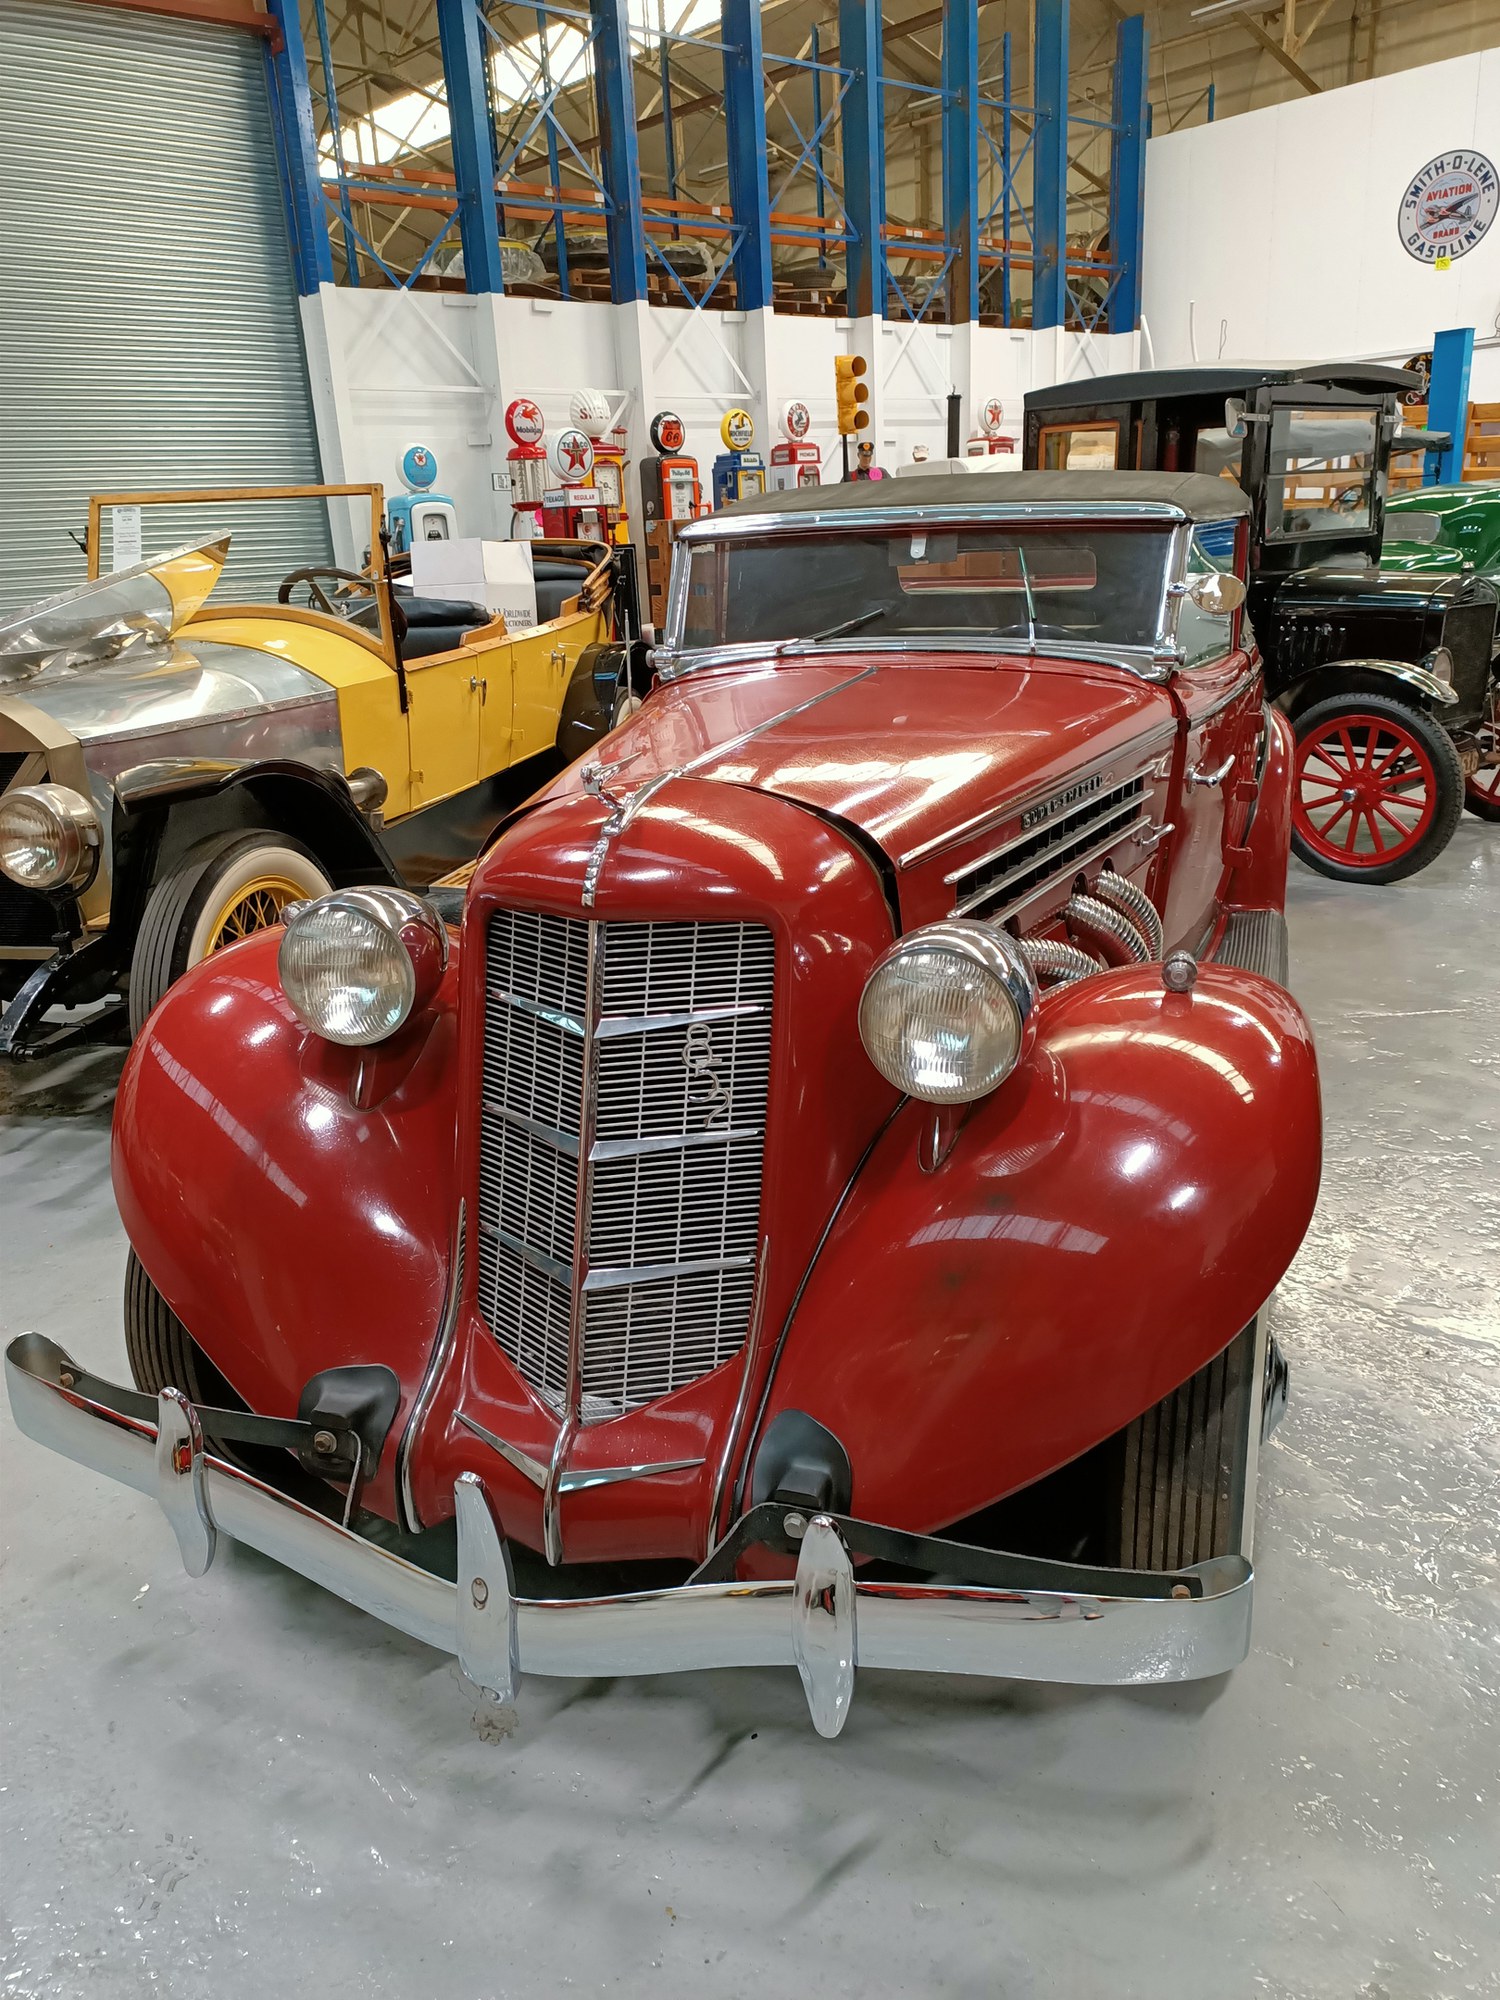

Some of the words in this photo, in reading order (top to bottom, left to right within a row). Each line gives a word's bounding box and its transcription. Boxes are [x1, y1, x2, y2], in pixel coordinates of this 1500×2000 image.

[1405, 155, 1495, 209] SMITH-O-LENE
[1426, 183, 1472, 202] AVIATION
[1407, 219, 1486, 259] GASOLINE
[1432, 227, 1460, 239] BRAND
[666, 431, 679, 442] 66
